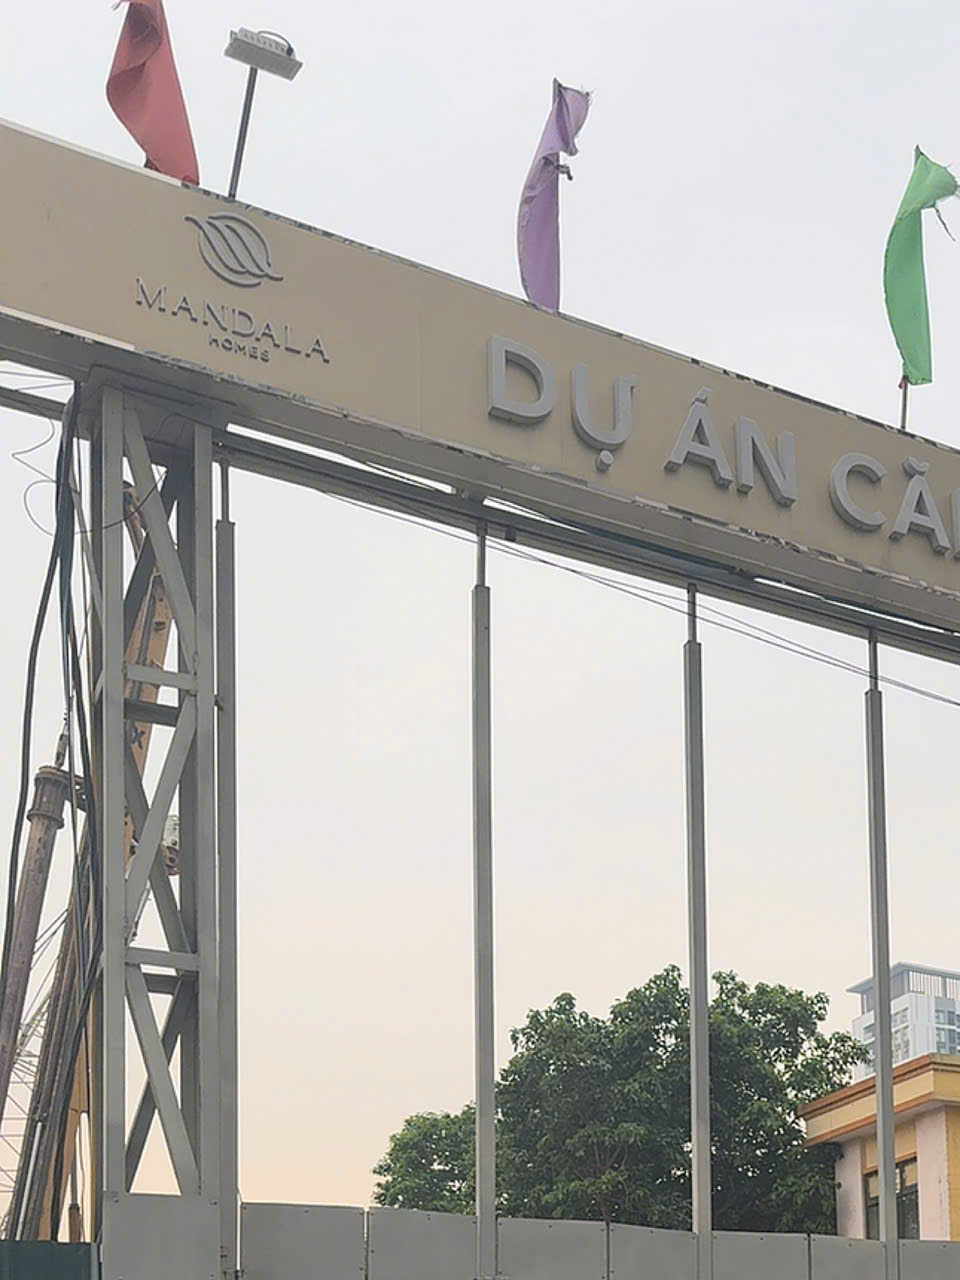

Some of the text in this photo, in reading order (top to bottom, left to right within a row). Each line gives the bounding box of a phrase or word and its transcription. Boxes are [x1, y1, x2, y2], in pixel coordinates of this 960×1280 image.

[135, 276, 330, 365] MANDALA
[209, 334, 270, 363] HOMES
[487, 333, 641, 474] DỰ
[664, 386, 797, 508] ÁN
